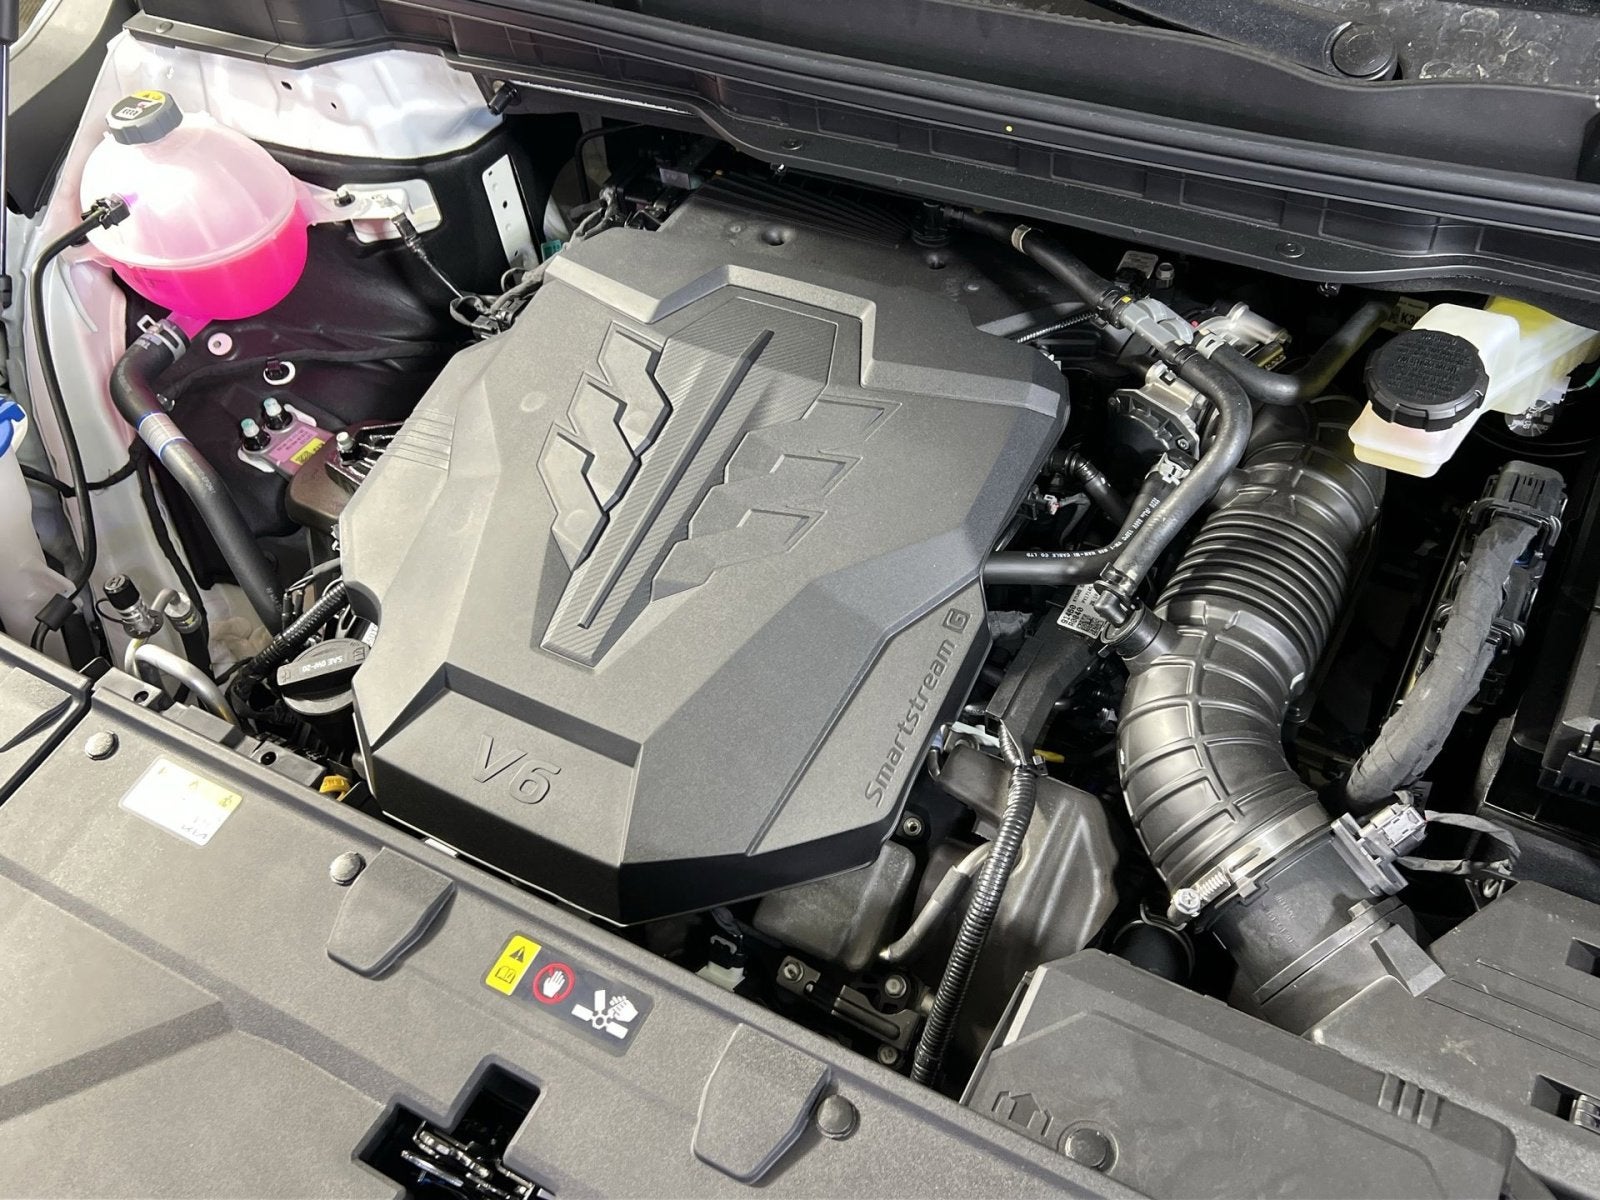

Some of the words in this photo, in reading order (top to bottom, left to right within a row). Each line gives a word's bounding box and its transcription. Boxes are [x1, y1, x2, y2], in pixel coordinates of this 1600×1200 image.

[327, 655, 344, 667] SAE
[864, 639, 958, 809] Smartstream
[473, 734, 562, 804] V6
